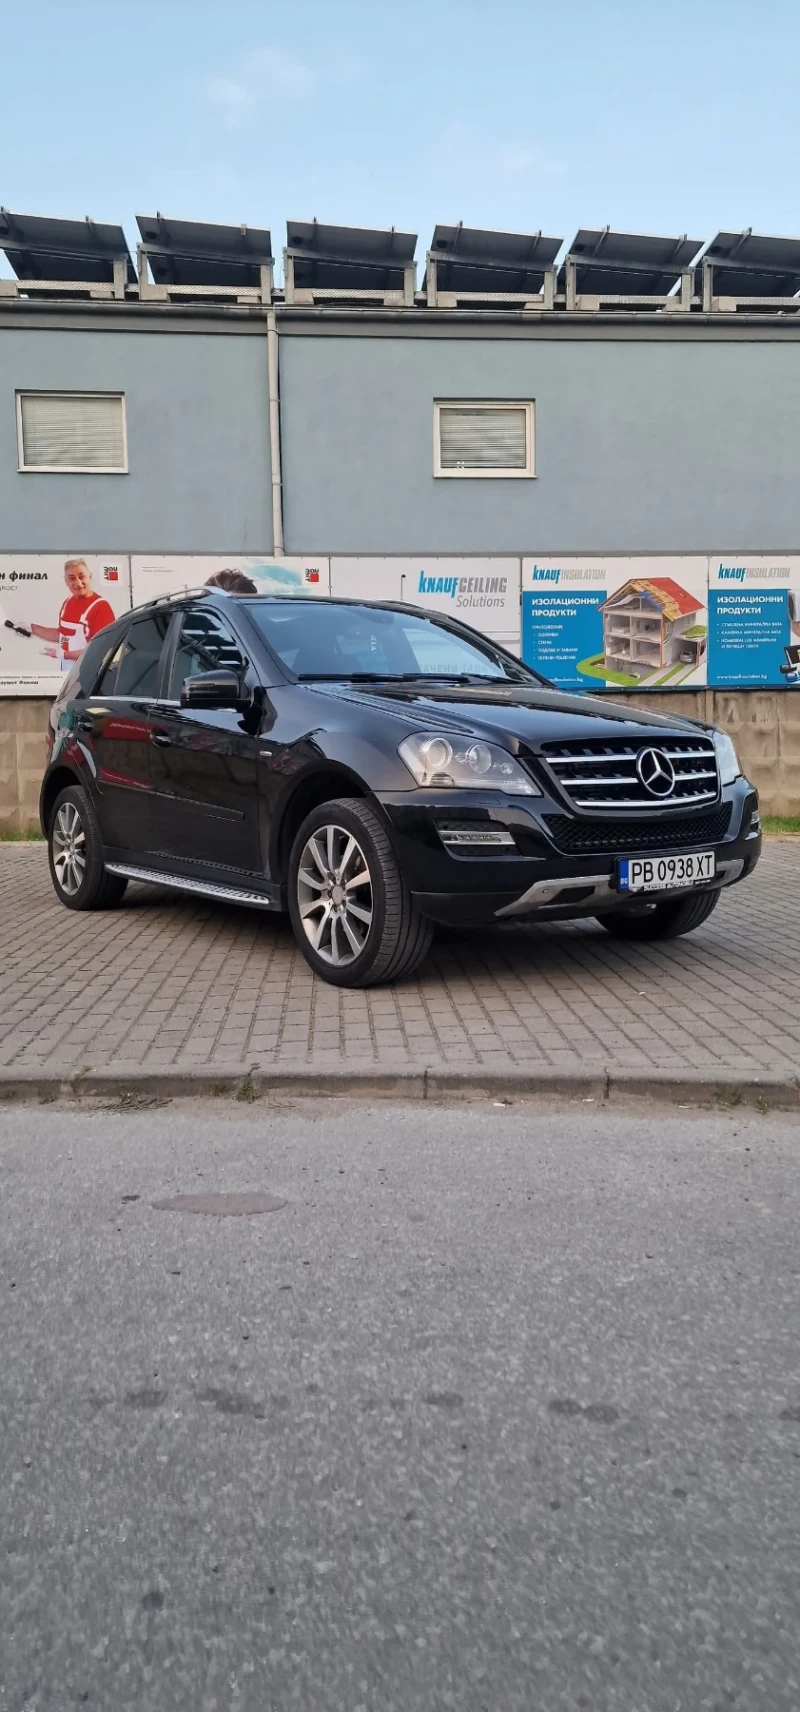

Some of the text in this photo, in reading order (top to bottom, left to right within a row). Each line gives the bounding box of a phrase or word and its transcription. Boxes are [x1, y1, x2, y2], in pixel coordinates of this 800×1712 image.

[9, 570, 48, 582] финал
[456, 594, 505, 608] Solutions
[531, 597, 599, 606] ИЗОЛАЦИОННИ
[717, 595, 784, 605] ИЗОЛАЦИОННИ
[531, 609, 577, 617] ПРОДУКТИ
[717, 607, 762, 615] ПРОДУКТИ
[631, 854, 713, 884] PB 0938 XT
